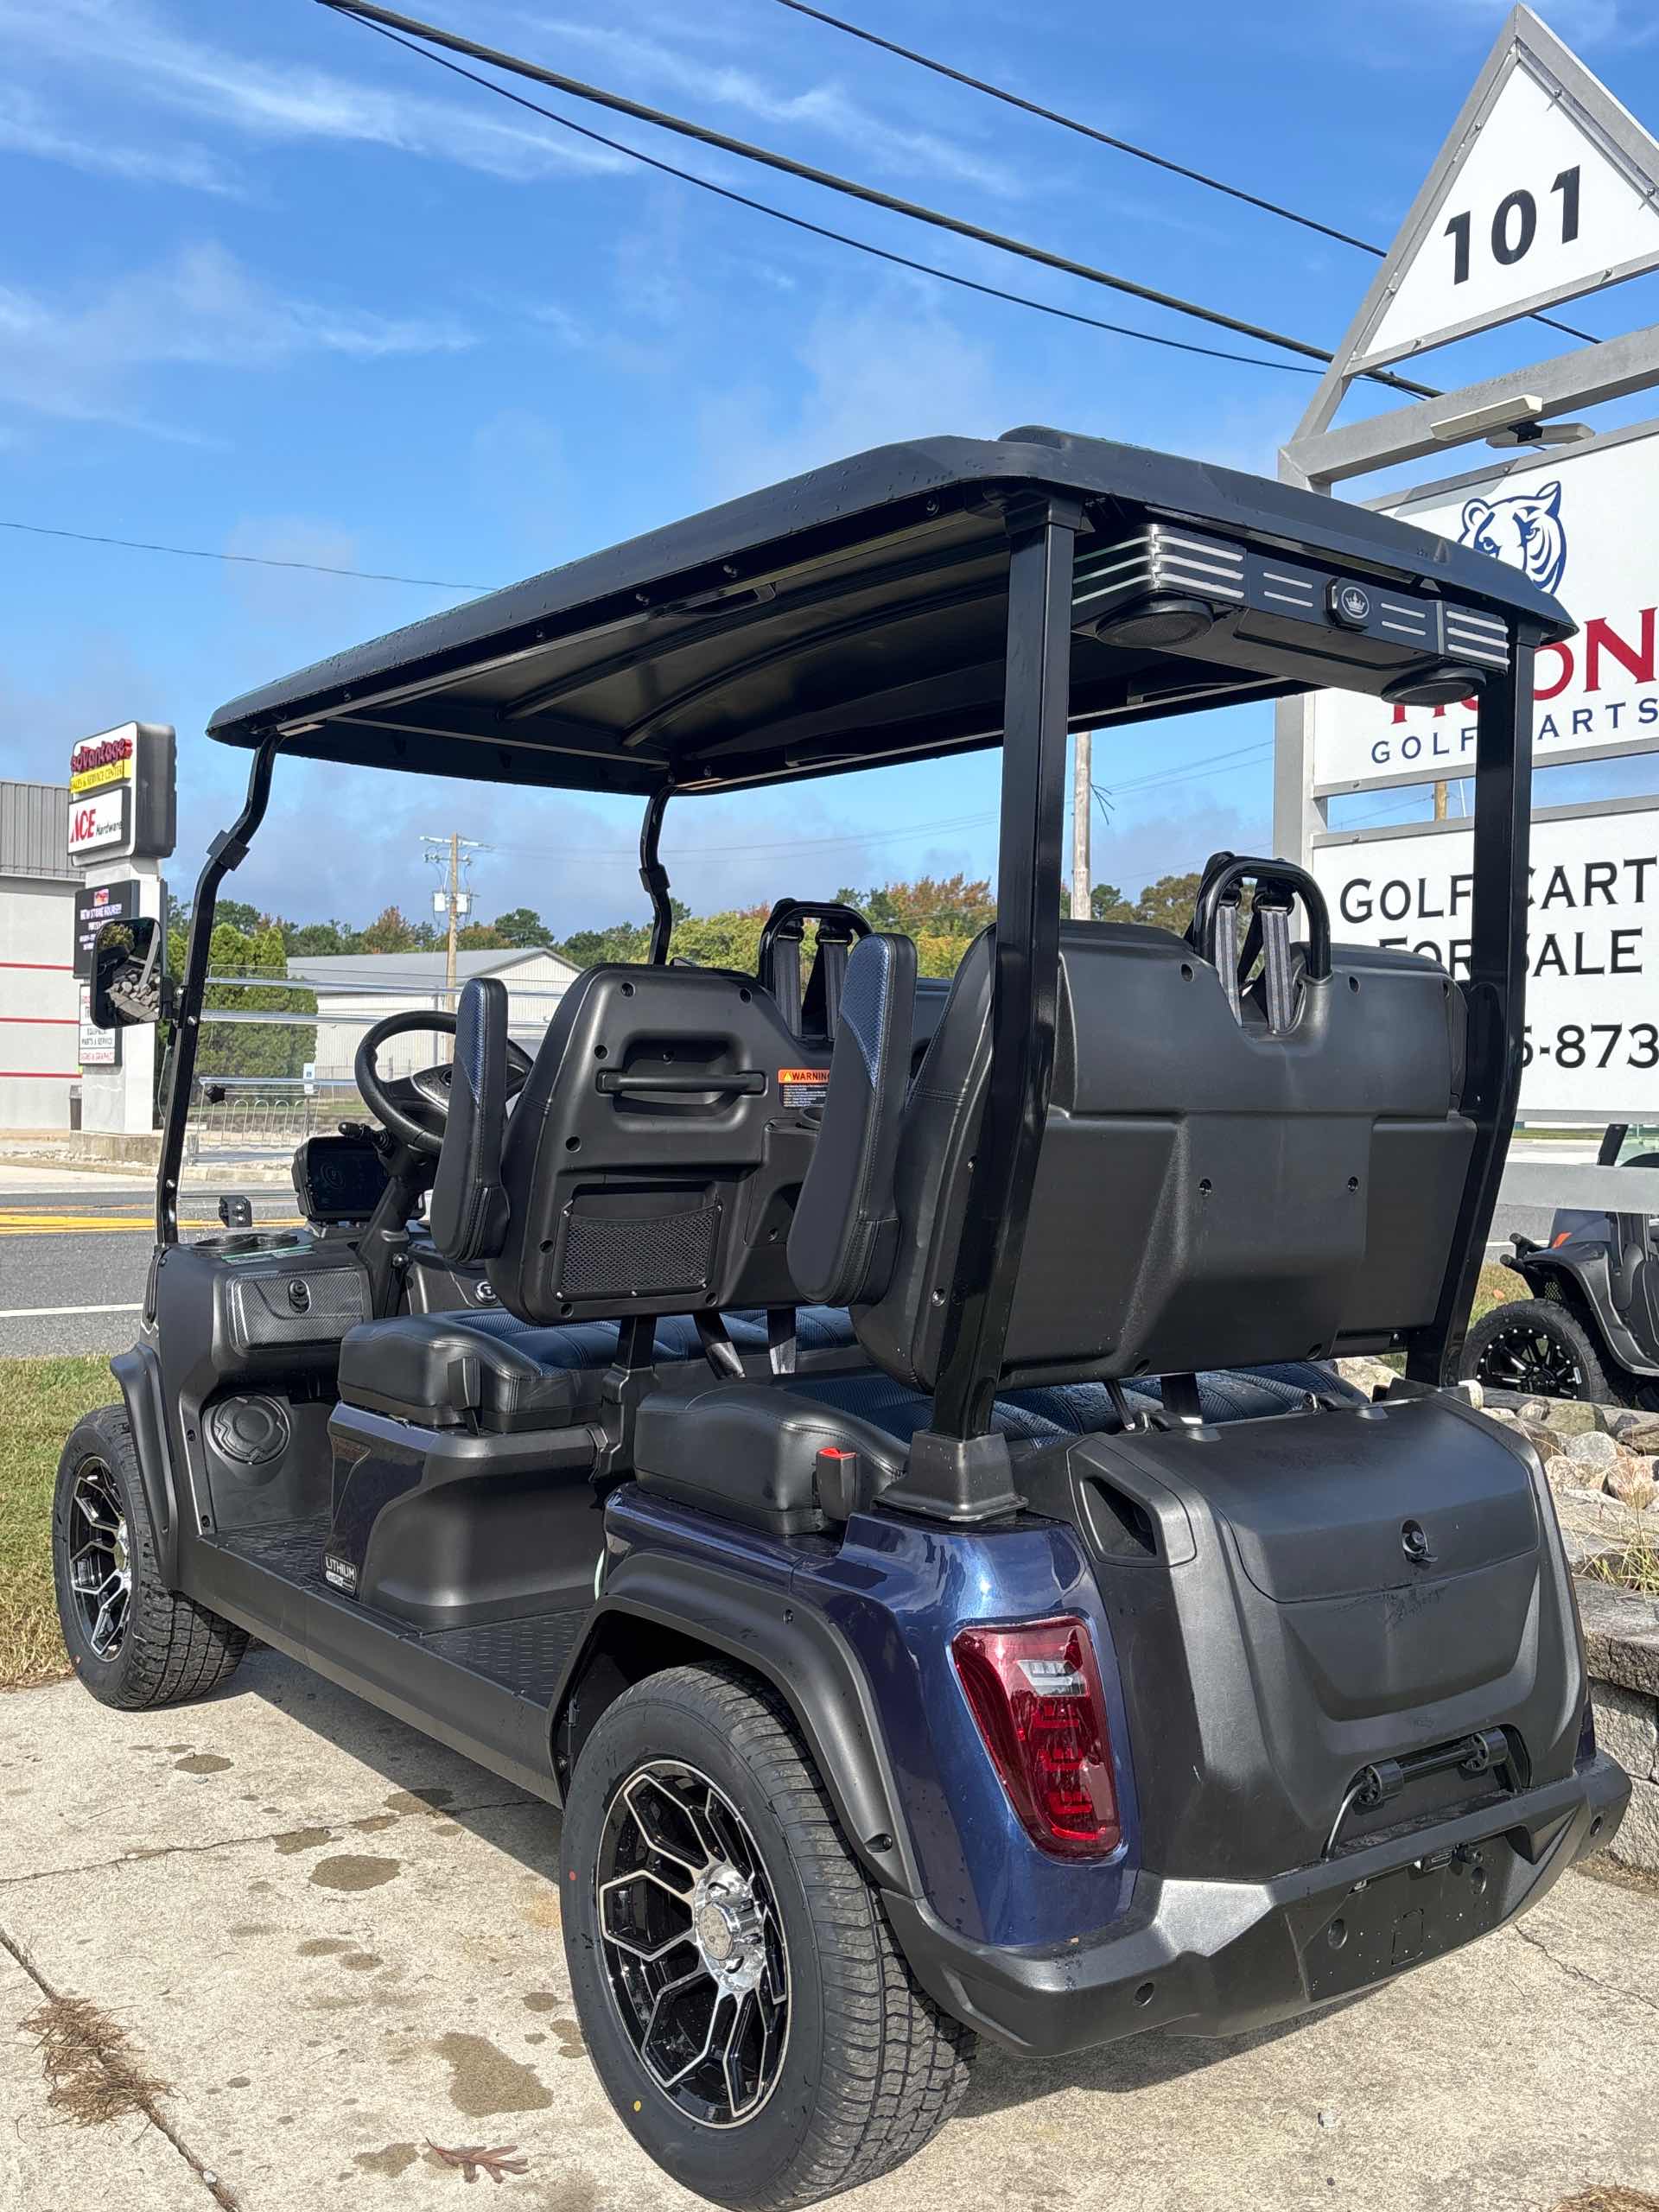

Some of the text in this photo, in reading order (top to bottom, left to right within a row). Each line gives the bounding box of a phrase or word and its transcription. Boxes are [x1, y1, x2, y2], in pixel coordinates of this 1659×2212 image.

[1443, 165, 1580, 285] 101
[1371, 697, 1659, 764] GOLF ARTS
[69, 809, 97, 843] ACE
[96, 821, 124, 836] Hardware
[1340, 855, 1657, 924] GOLF ART
[1527, 927, 1643, 977] ALE
[325, 1556, 355, 1581] LITHIUM
